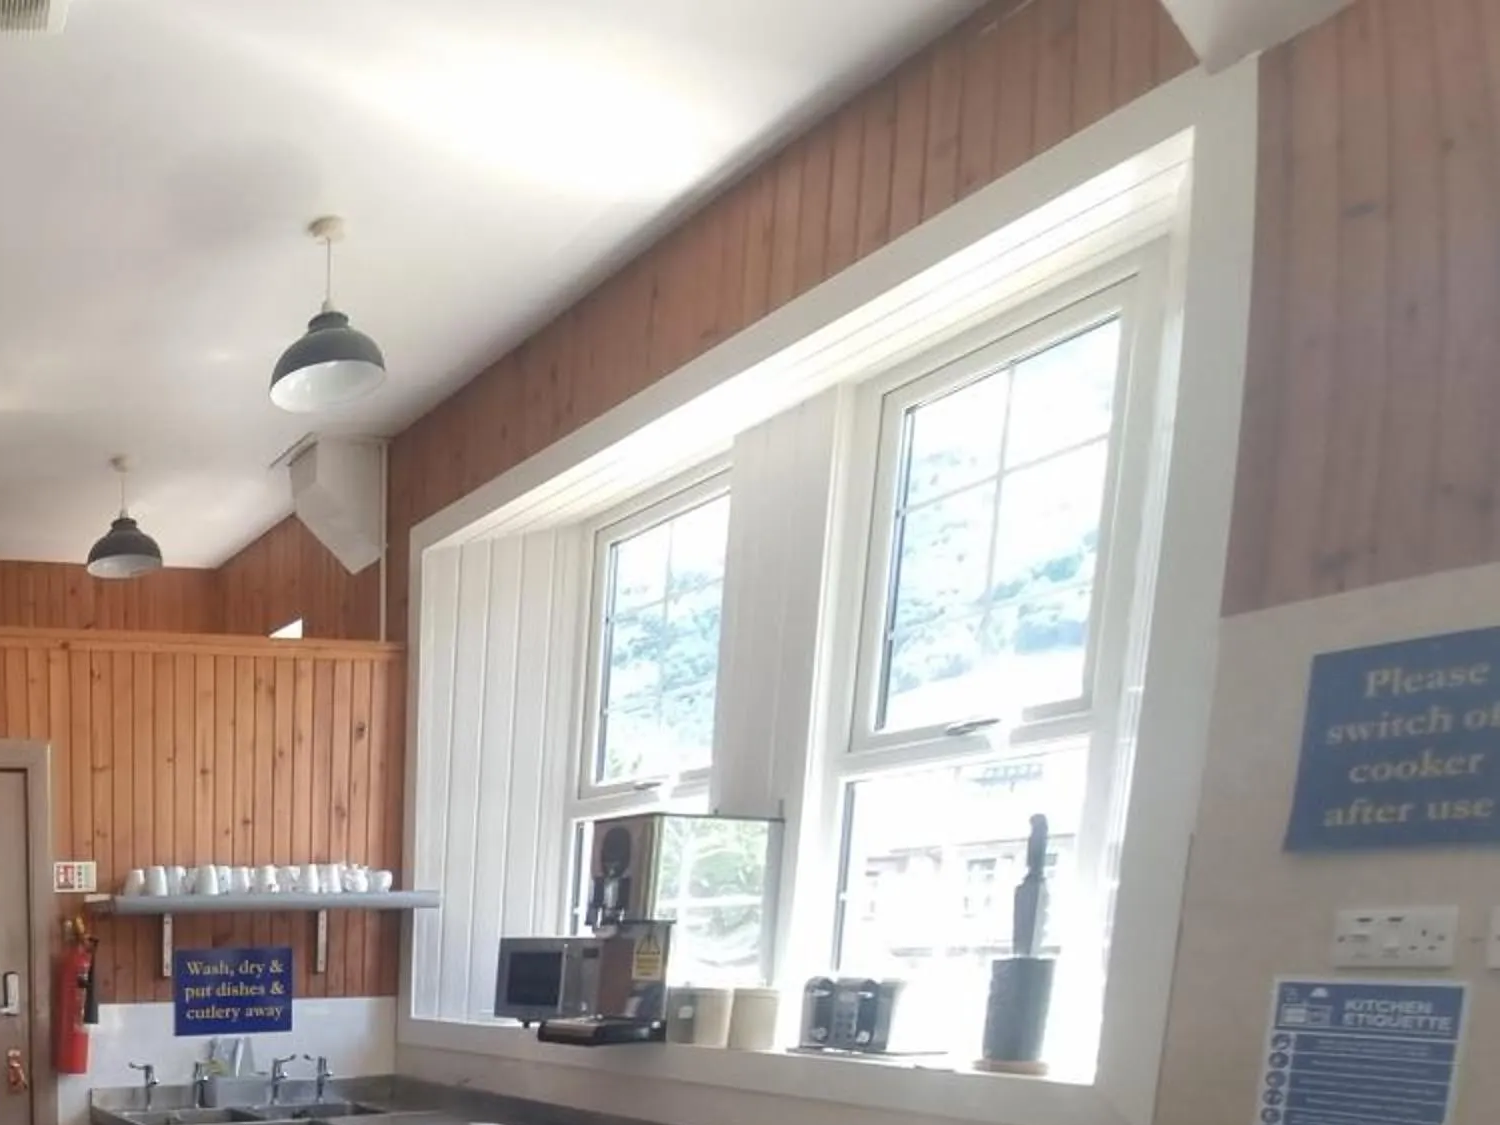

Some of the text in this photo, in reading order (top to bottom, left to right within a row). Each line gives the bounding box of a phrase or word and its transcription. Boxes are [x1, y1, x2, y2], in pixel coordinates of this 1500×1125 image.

[1364, 661, 1491, 699] Please
[1325, 704, 1453, 745] switch
[1348, 748, 1485, 784] cooker
[1323, 797, 1495, 828] after use
[186, 960, 284, 979] Wash, dry &
[185, 980, 285, 1004] put dishes &
[186, 1004, 284, 1022] cutlery away
[1343, 999, 1433, 1015] KITCHEN
[1342, 1013, 1453, 1031] ETIQUETTE
